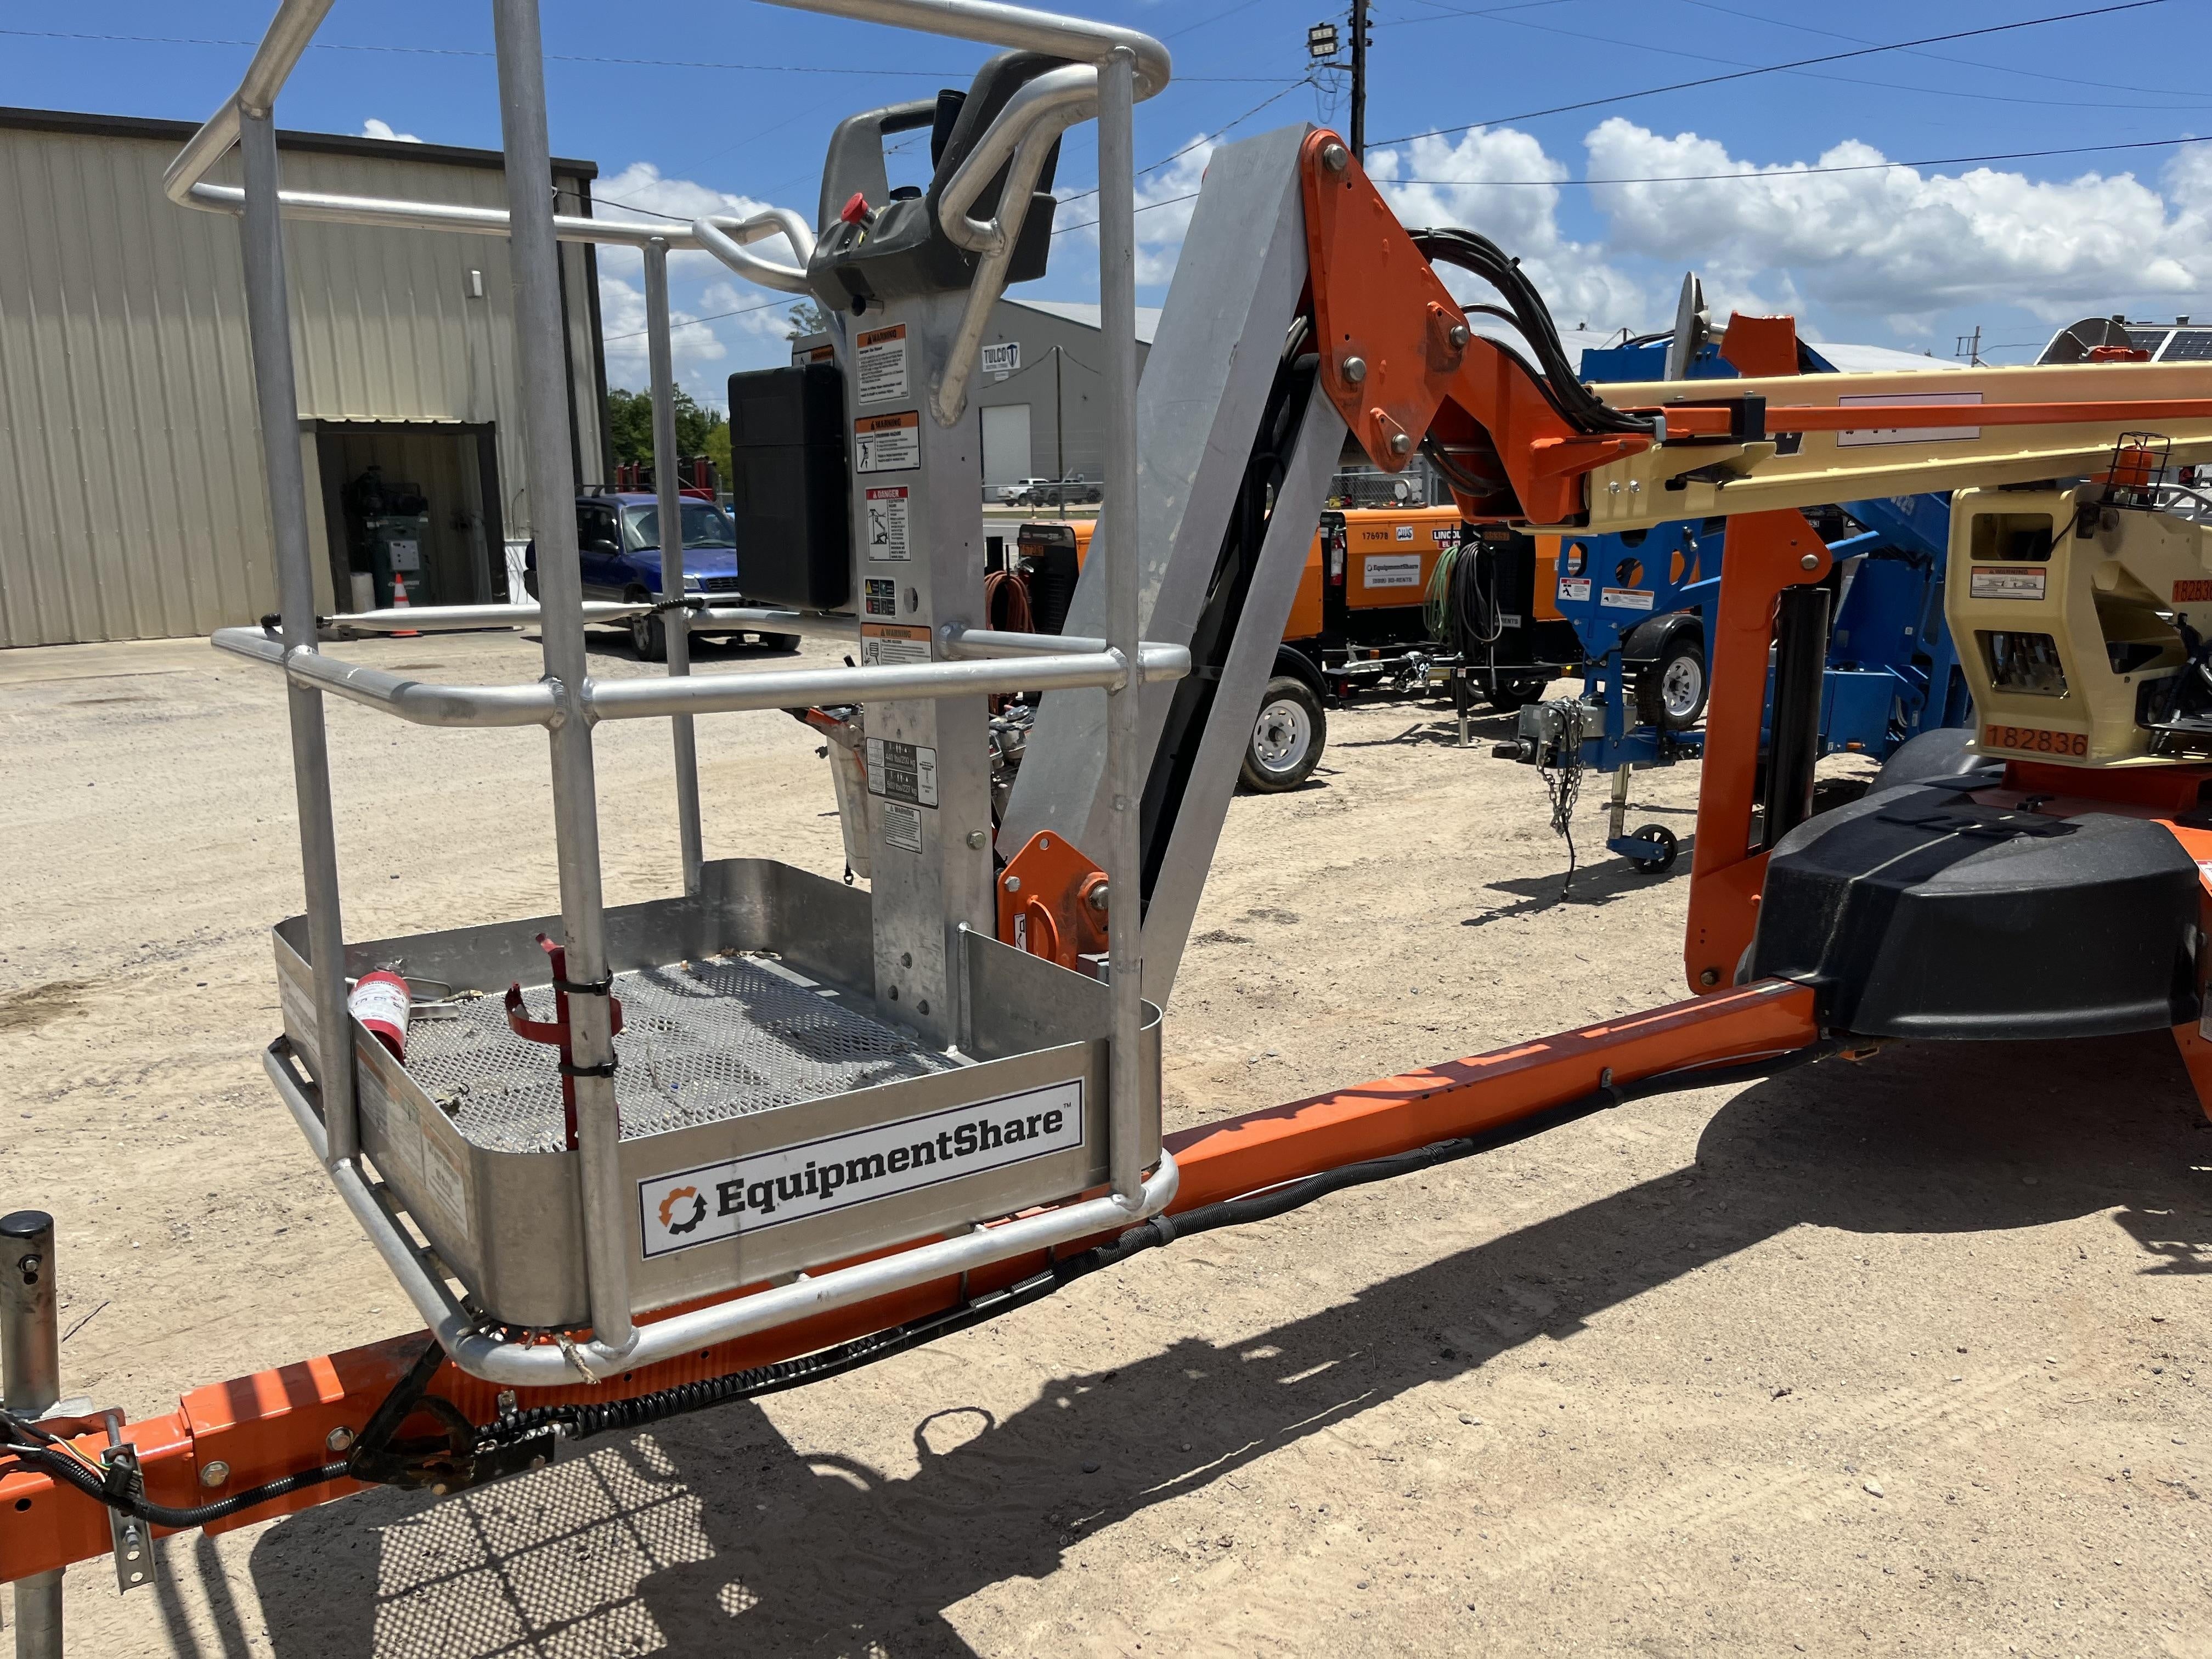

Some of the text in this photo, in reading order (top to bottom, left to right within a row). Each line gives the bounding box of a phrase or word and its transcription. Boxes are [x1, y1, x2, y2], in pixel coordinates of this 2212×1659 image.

[1434, 531, 1460, 539] LINCOL
[1373, 563, 1419, 572] EquipmentShare
[886, 628, 911, 638] WARNING
[1988, 725, 2087, 755] 182836
[894, 806, 914, 817] WARNING
[716, 1108, 1064, 1217] EquipmentShare
